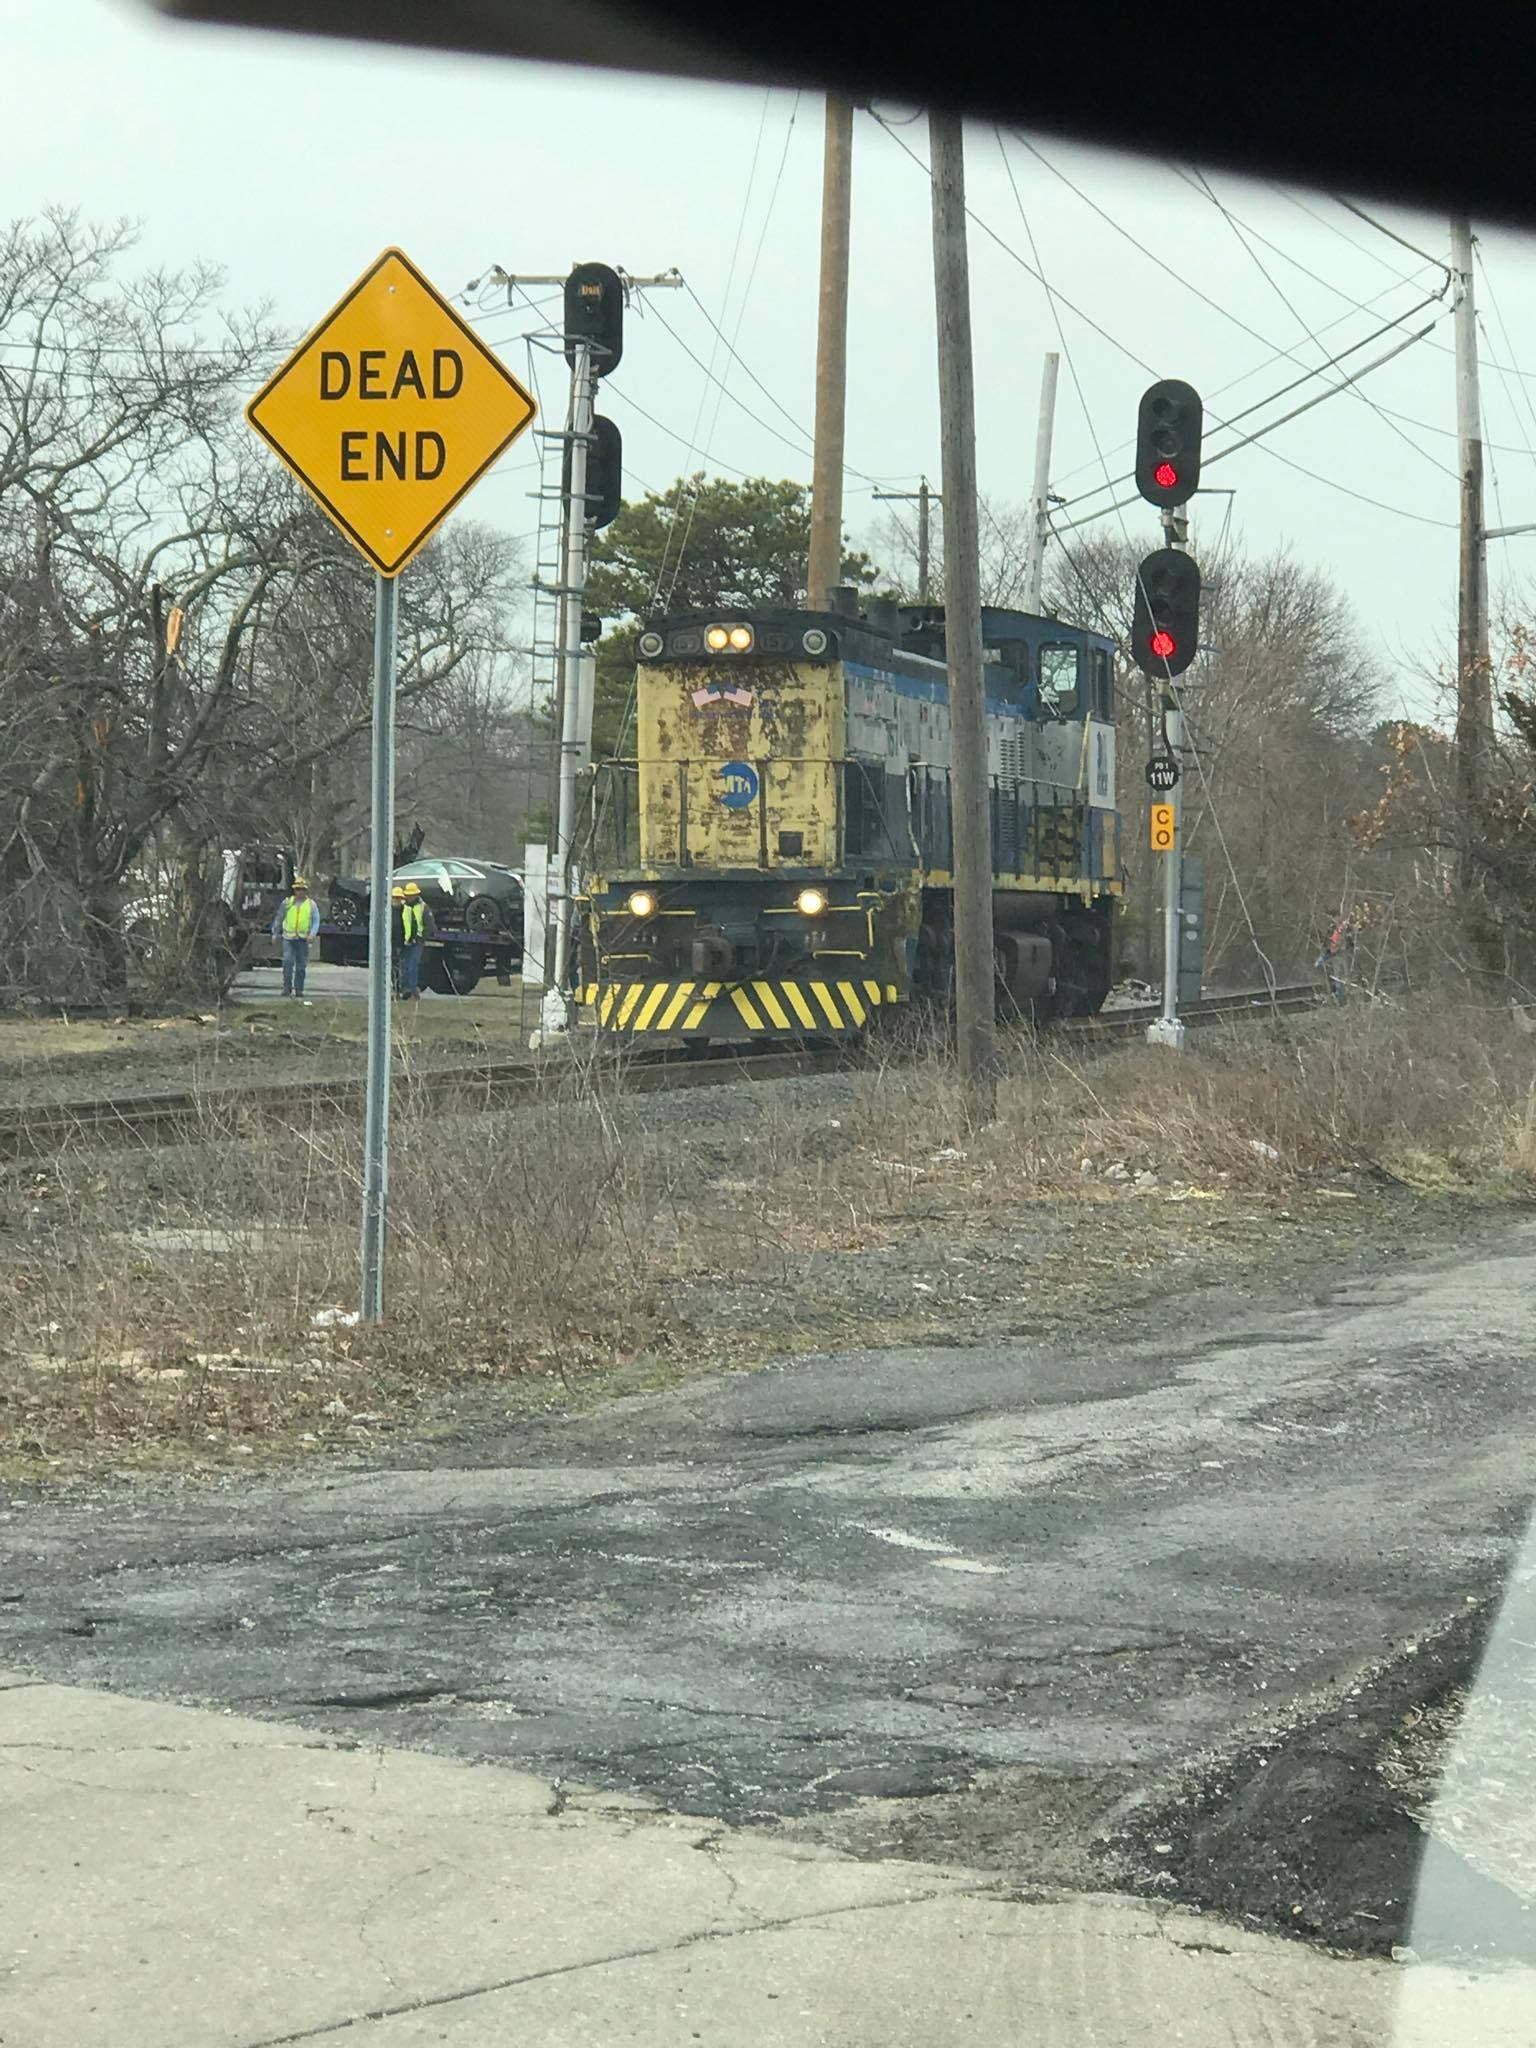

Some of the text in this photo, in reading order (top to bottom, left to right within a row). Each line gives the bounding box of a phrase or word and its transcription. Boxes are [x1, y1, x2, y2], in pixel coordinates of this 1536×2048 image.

[320, 349, 464, 400] DEAD
[341, 431, 446, 481] END
[1150, 772, 1174, 785] 11W
